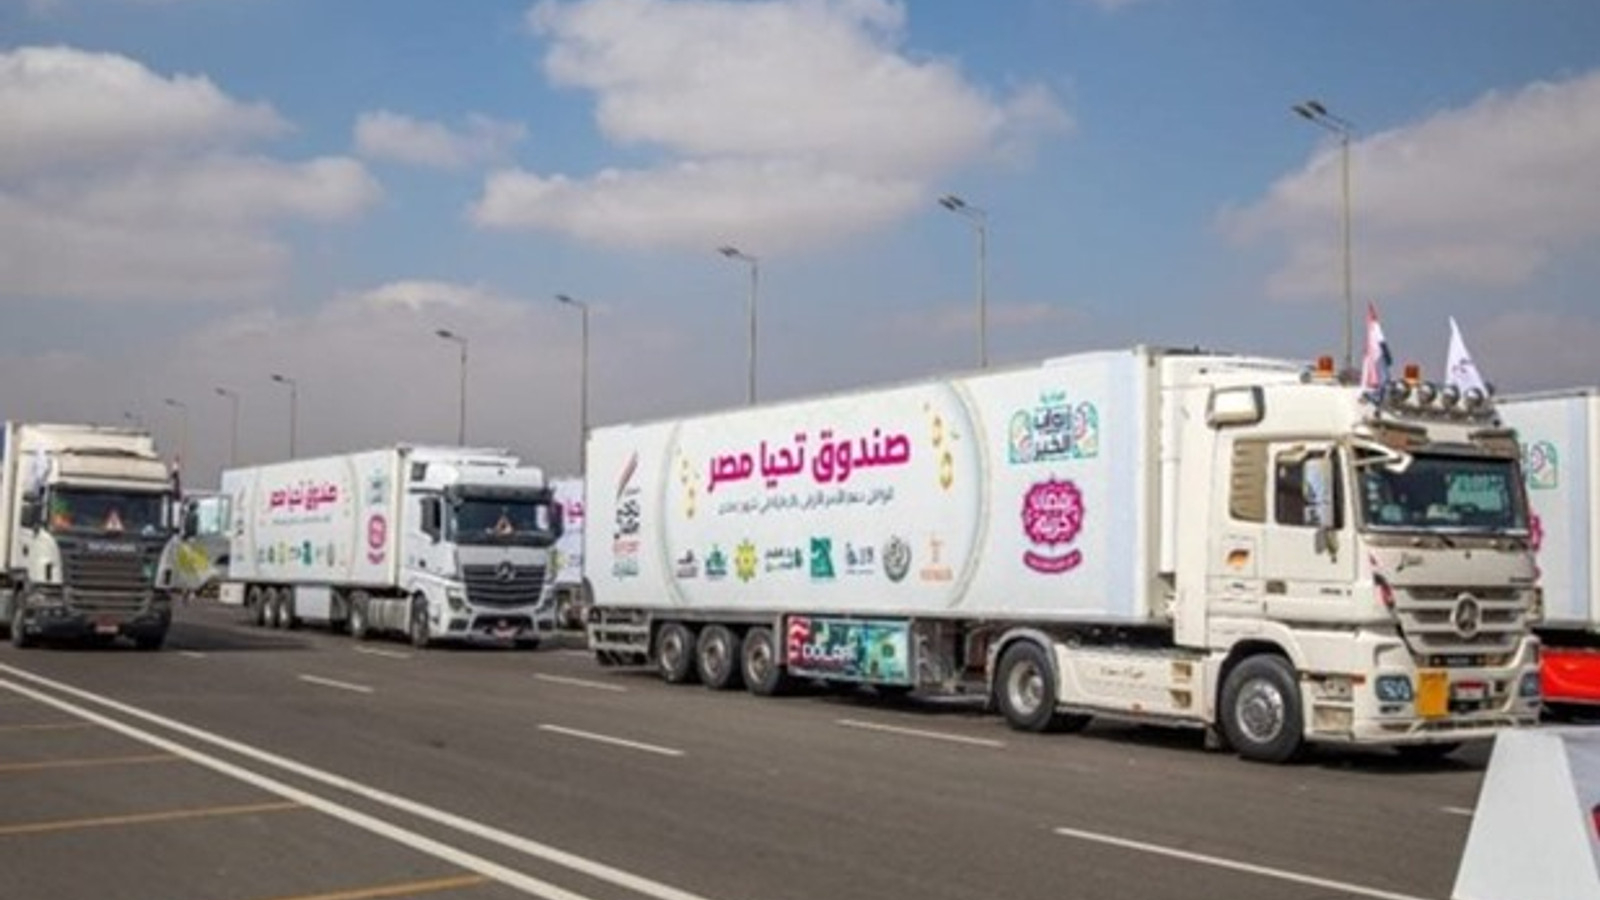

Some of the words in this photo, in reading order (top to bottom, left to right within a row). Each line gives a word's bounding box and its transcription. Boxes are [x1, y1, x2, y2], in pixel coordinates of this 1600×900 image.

[707, 452, 754, 493] مصر
[760, 433, 807, 489] تحيا
[812, 428, 910, 484] صندوق
